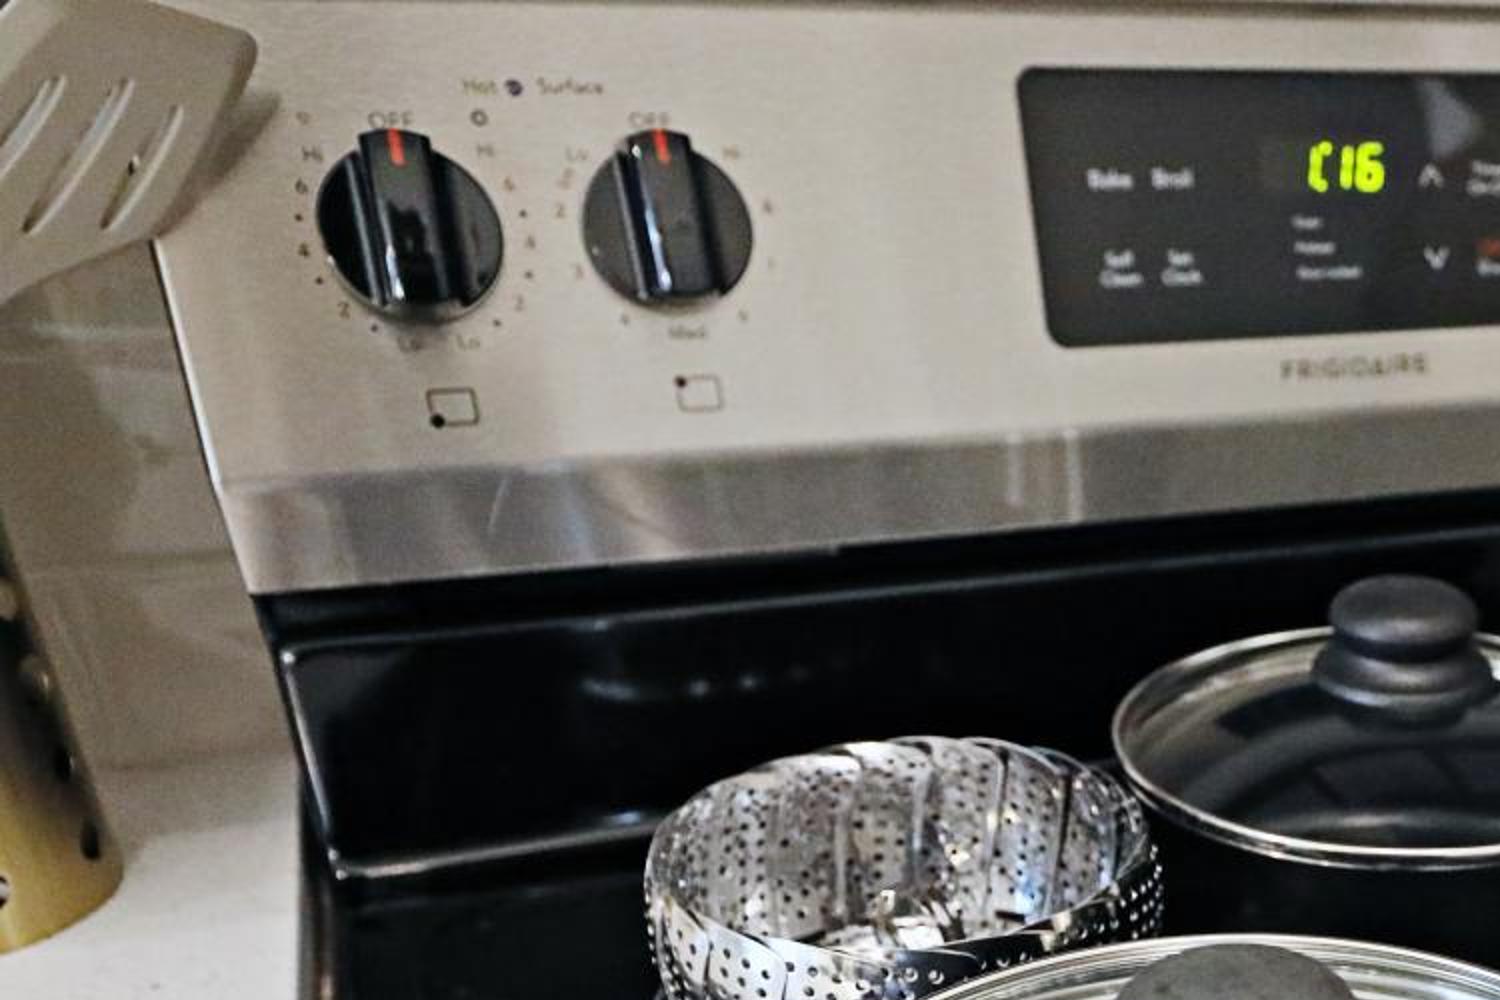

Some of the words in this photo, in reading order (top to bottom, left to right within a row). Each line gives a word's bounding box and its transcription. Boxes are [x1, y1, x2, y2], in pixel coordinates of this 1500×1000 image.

[536, 77, 604, 95] Surface
[368, 111, 414, 129] OFF
[1279, 352, 1429, 379] FRIGIDAIRE
